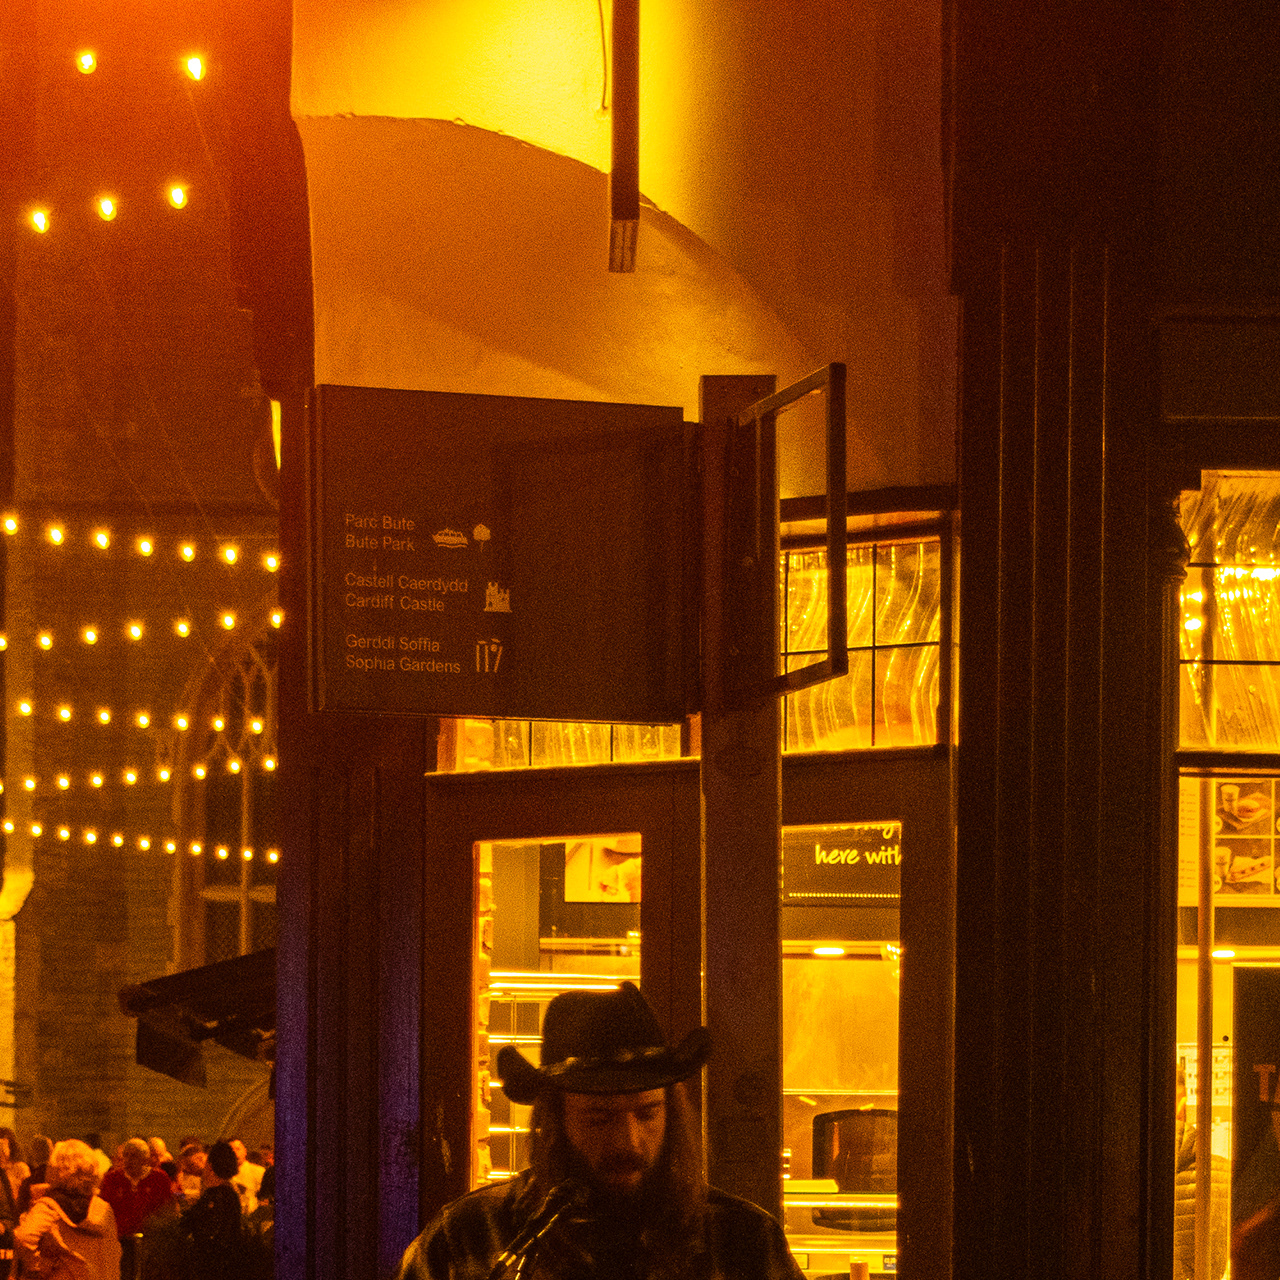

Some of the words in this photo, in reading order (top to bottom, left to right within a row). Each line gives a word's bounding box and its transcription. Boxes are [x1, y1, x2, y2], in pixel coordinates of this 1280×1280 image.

[345, 514, 378, 528] Parc
[382, 515, 416, 531] Bute
[345, 534, 379, 549] Bute
[383, 536, 416, 552] Park
[345, 572, 394, 588] Castell
[398, 575, 469, 595] Caerdydd
[345, 593, 395, 609] Cardiff
[400, 596, 445, 612] Castle
[345, 634, 395, 649] Gerddi
[399, 637, 440, 652] Soffia
[345, 655, 395, 672] Sophia
[400, 657, 462, 673] Gardens
[815, 844, 860, 865] here
